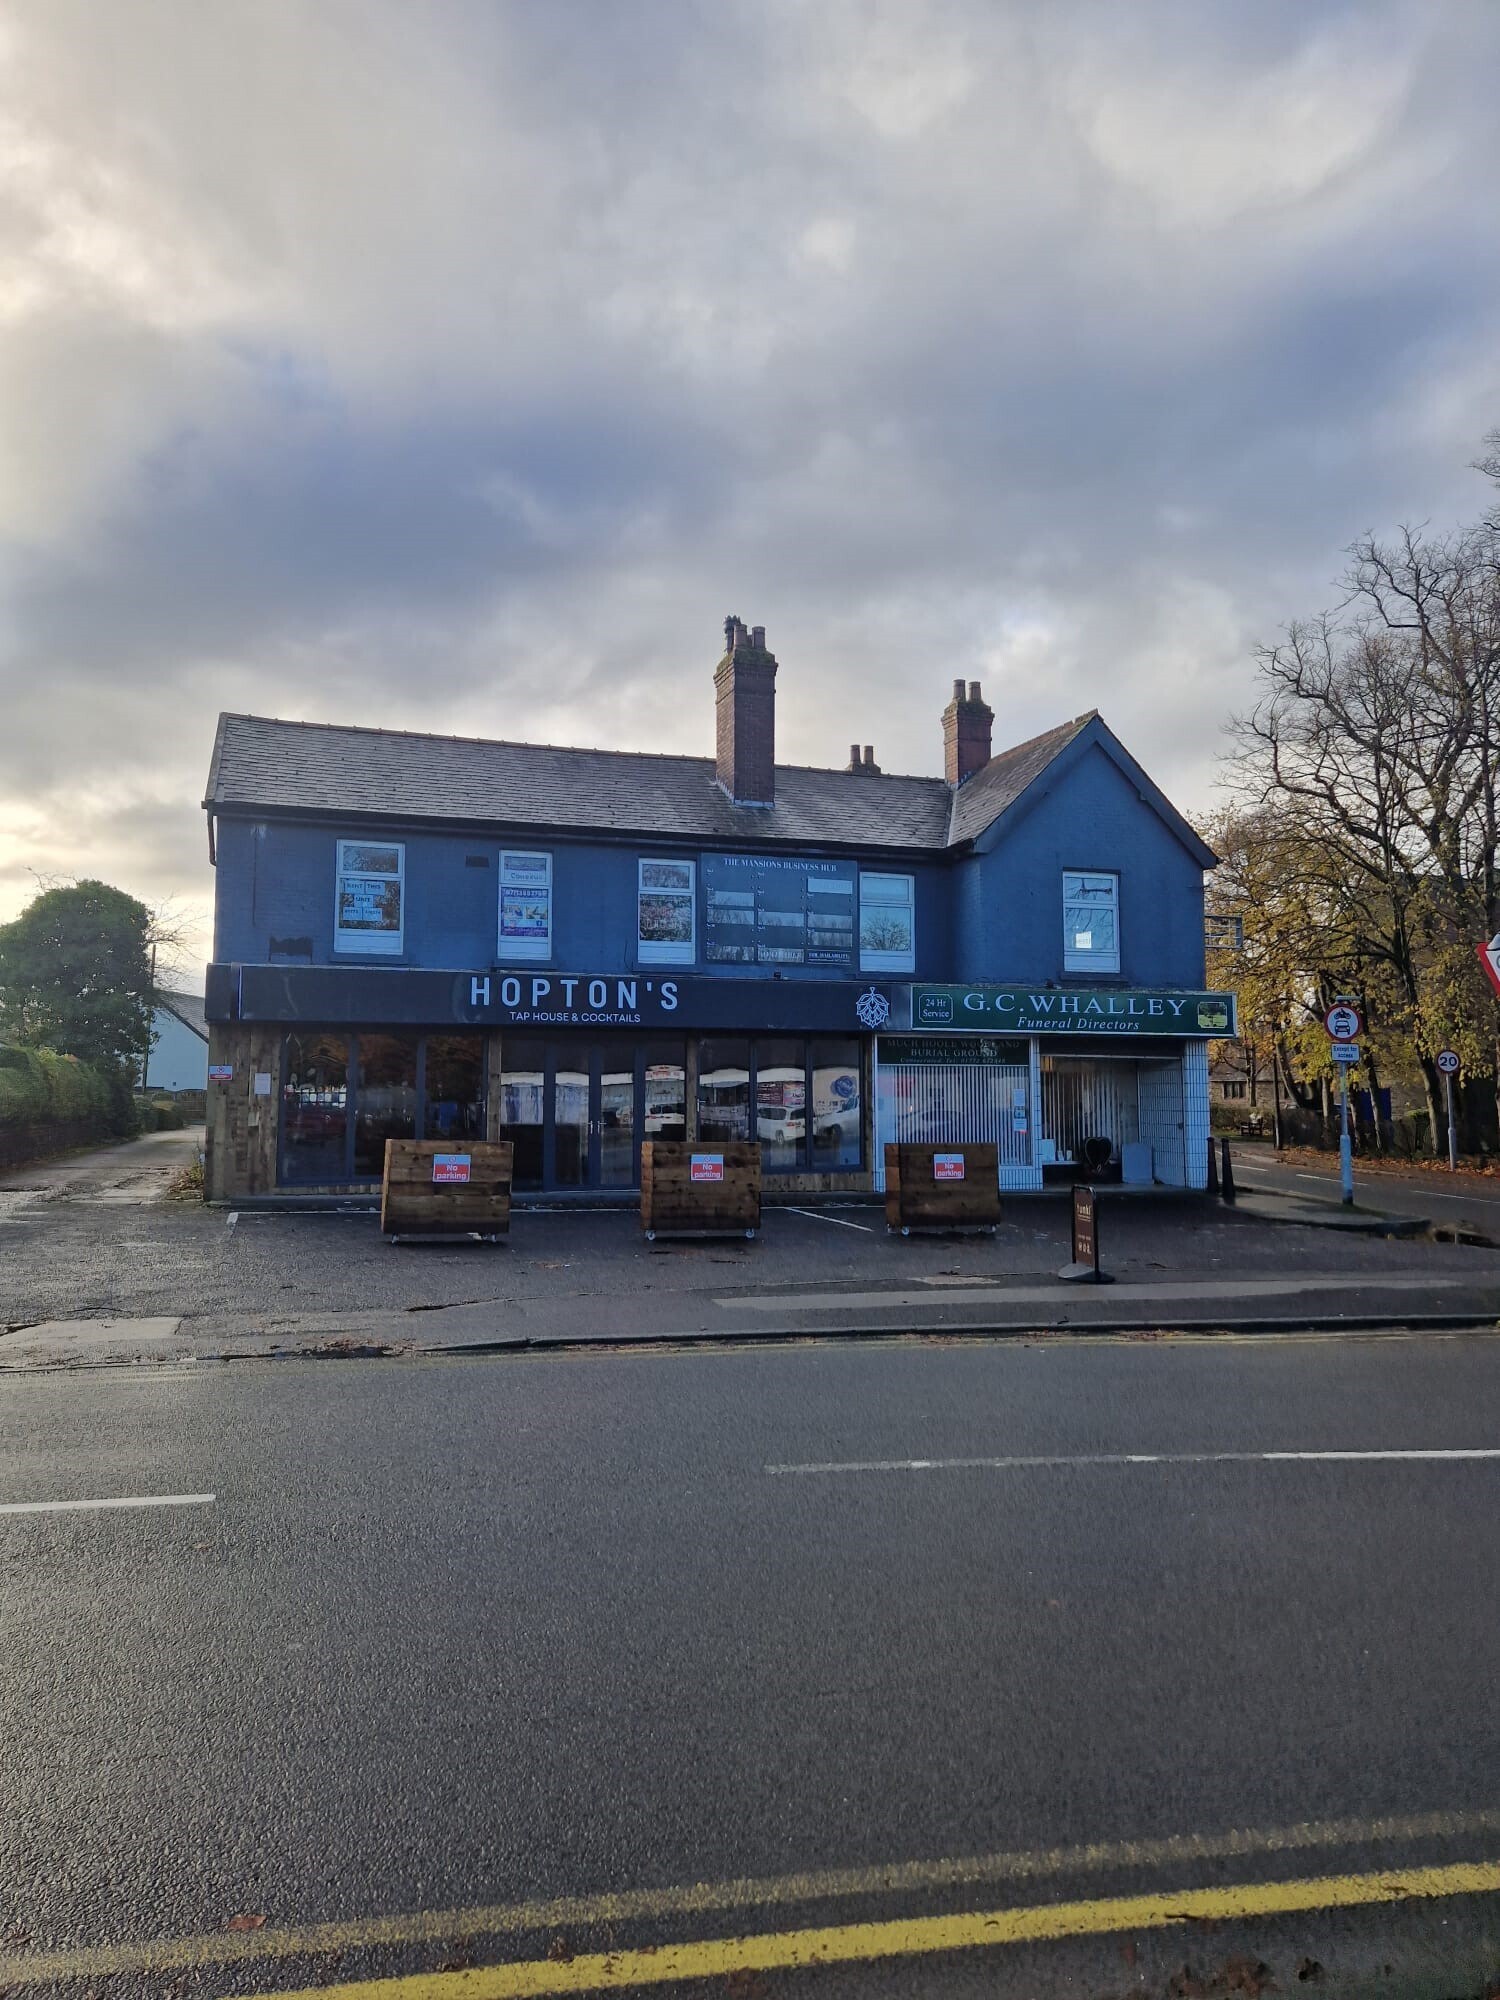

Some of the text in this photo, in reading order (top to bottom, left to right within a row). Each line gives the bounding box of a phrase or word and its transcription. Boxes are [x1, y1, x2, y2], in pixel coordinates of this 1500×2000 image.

[724, 858, 837, 872] THE MANSIONS BUSINESS HUB
[471, 976, 679, 1010] HOPTON'S
[925, 998, 947, 1007] 24 Hr
[1028, 995, 1187, 1016] WHALLEY
[509, 1011, 641, 1023] TAP HOUSE & COCKTAILS
[922, 1009, 950, 1018] Service
[1017, 1016, 1140, 1030] Funeral Directors
[911, 1048, 998, 1057] BURIAL GROUND
[1439, 1056, 1457, 1067] 20
[436, 1172, 467, 1180] parking
